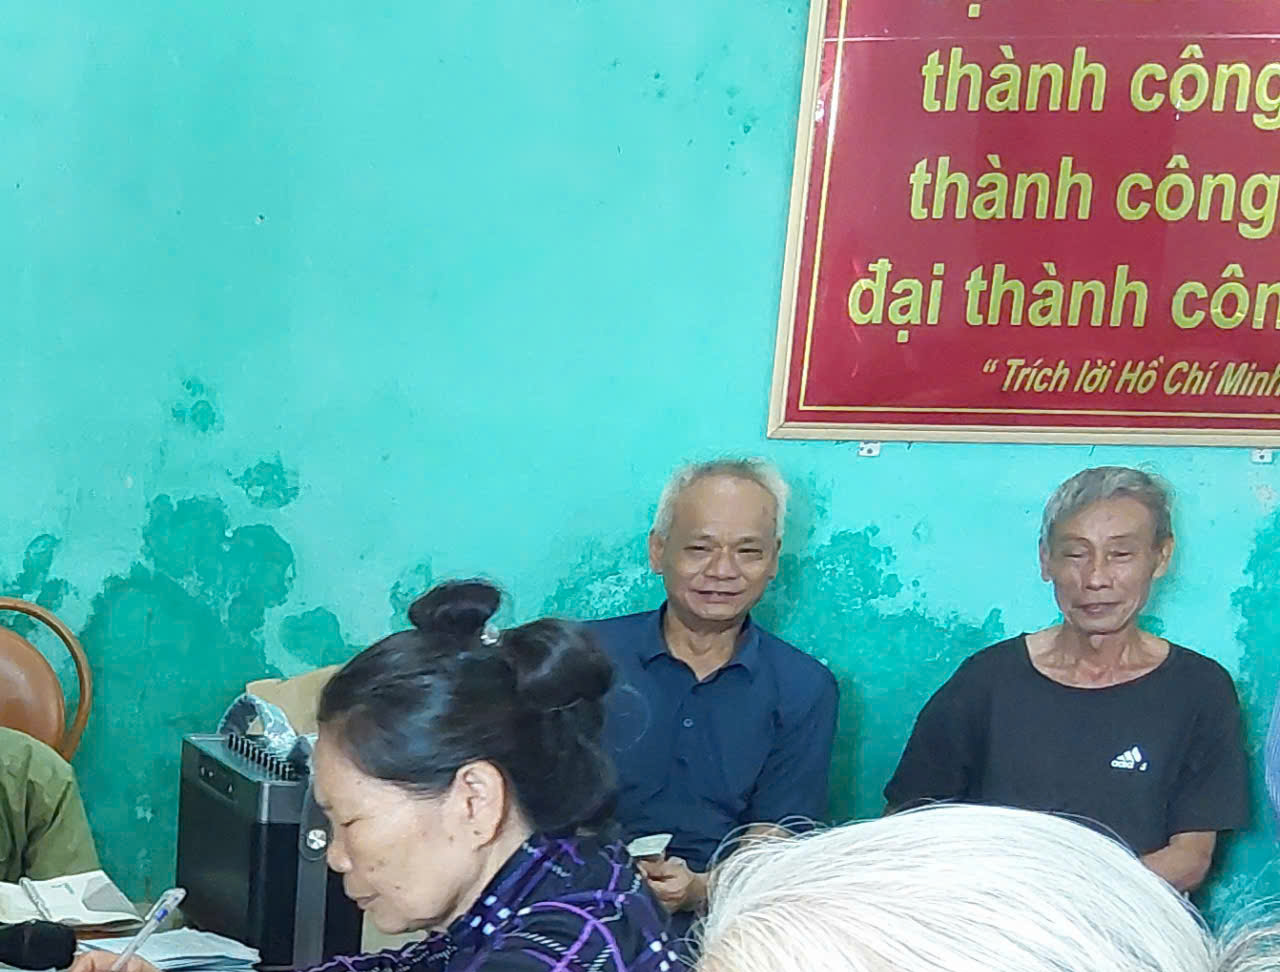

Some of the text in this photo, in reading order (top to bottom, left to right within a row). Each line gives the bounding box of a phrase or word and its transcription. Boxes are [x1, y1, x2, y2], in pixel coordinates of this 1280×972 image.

[921, 44, 1280, 130] thành công
[909, 154, 1280, 239] thành công
[848, 258, 945, 343] đại
[965, 263, 1148, 328] thành
[1073, 359, 1117, 394] lời
[1115, 355, 1165, 395] Hồ
[1164, 360, 1219, 396] Chí
[1215, 362, 1280, 397] Minh
